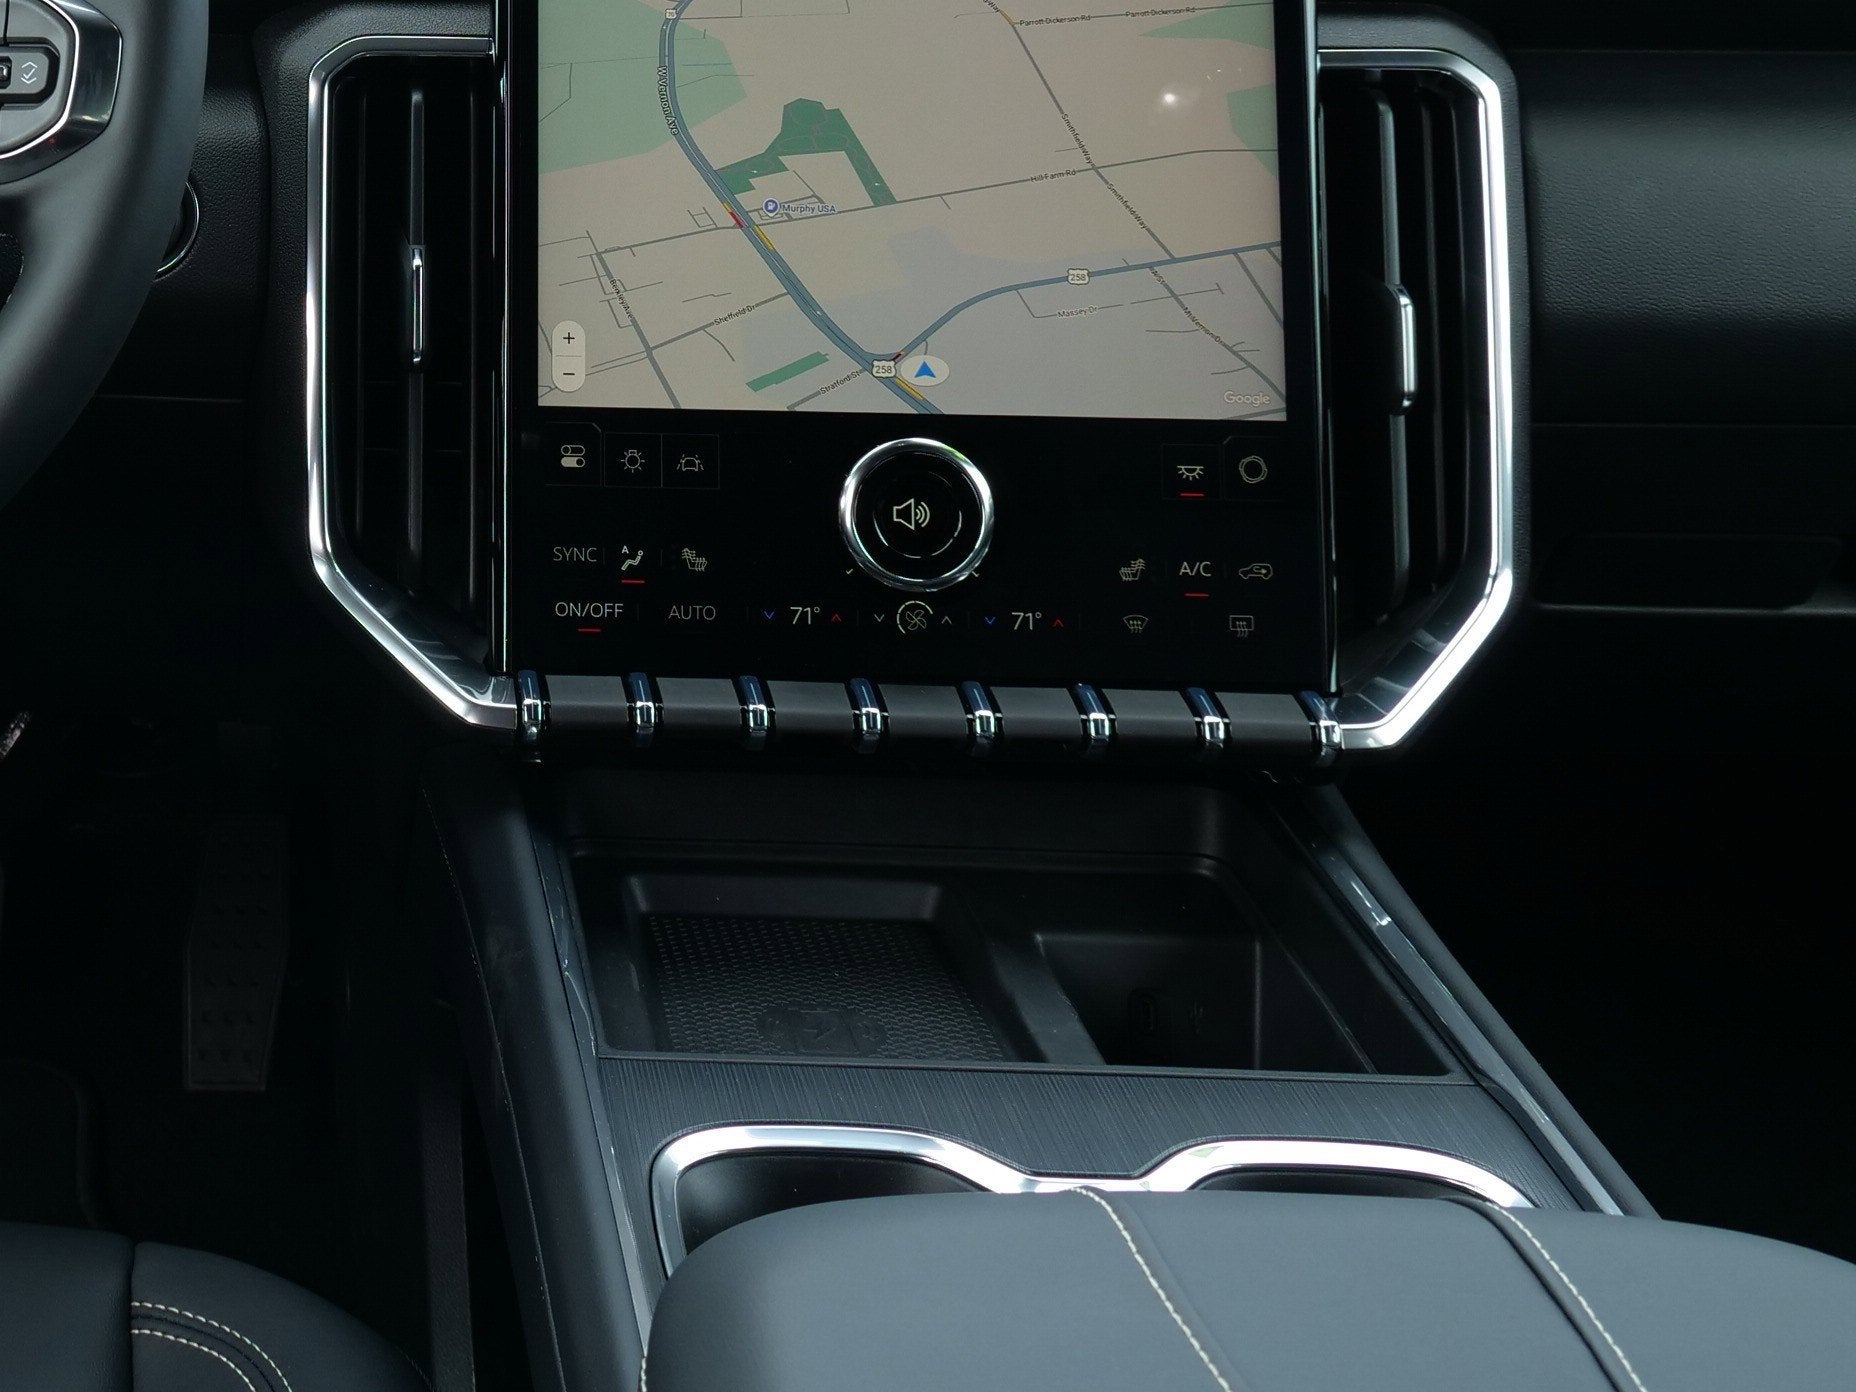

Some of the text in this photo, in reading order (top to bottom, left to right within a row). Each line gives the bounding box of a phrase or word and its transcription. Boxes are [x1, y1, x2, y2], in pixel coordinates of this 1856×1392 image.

[1125, 10, 1151, 18] Parrott
[1150, 8, 1185, 16] Dickerson
[1019, 18, 1045, 27] Parrott
[1045, 16, 1081, 25] Dickerson
[658, 79, 671, 115] Vernon
[666, 116, 679, 135] Ave
[1061, 113, 1094, 164] Smithfield Way
[1044, 172, 1065, 180] Farm
[1065, 168, 1076, 176] Rd
[782, 204, 836, 214] Murphy USA
[1107, 183, 1147, 230] Smithfield Way
[1070, 273, 1086, 281] 258
[714, 307, 746, 326] Sheffield
[1057, 306, 1098, 318] Massey Dr
[1191, 316, 1215, 338] Vernon
[875, 365, 893, 374] 258
[820, 370, 861, 395] Stratford St
[1223, 391, 1271, 407] Google
[553, 547, 597, 562] SYNC
[1179, 561, 1211, 577] A/C
[555, 601, 624, 618] ON/OFF
[668, 605, 716, 621] AUTO
[790, 606, 820, 625] 71°
[1011, 611, 1042, 630] 71°
